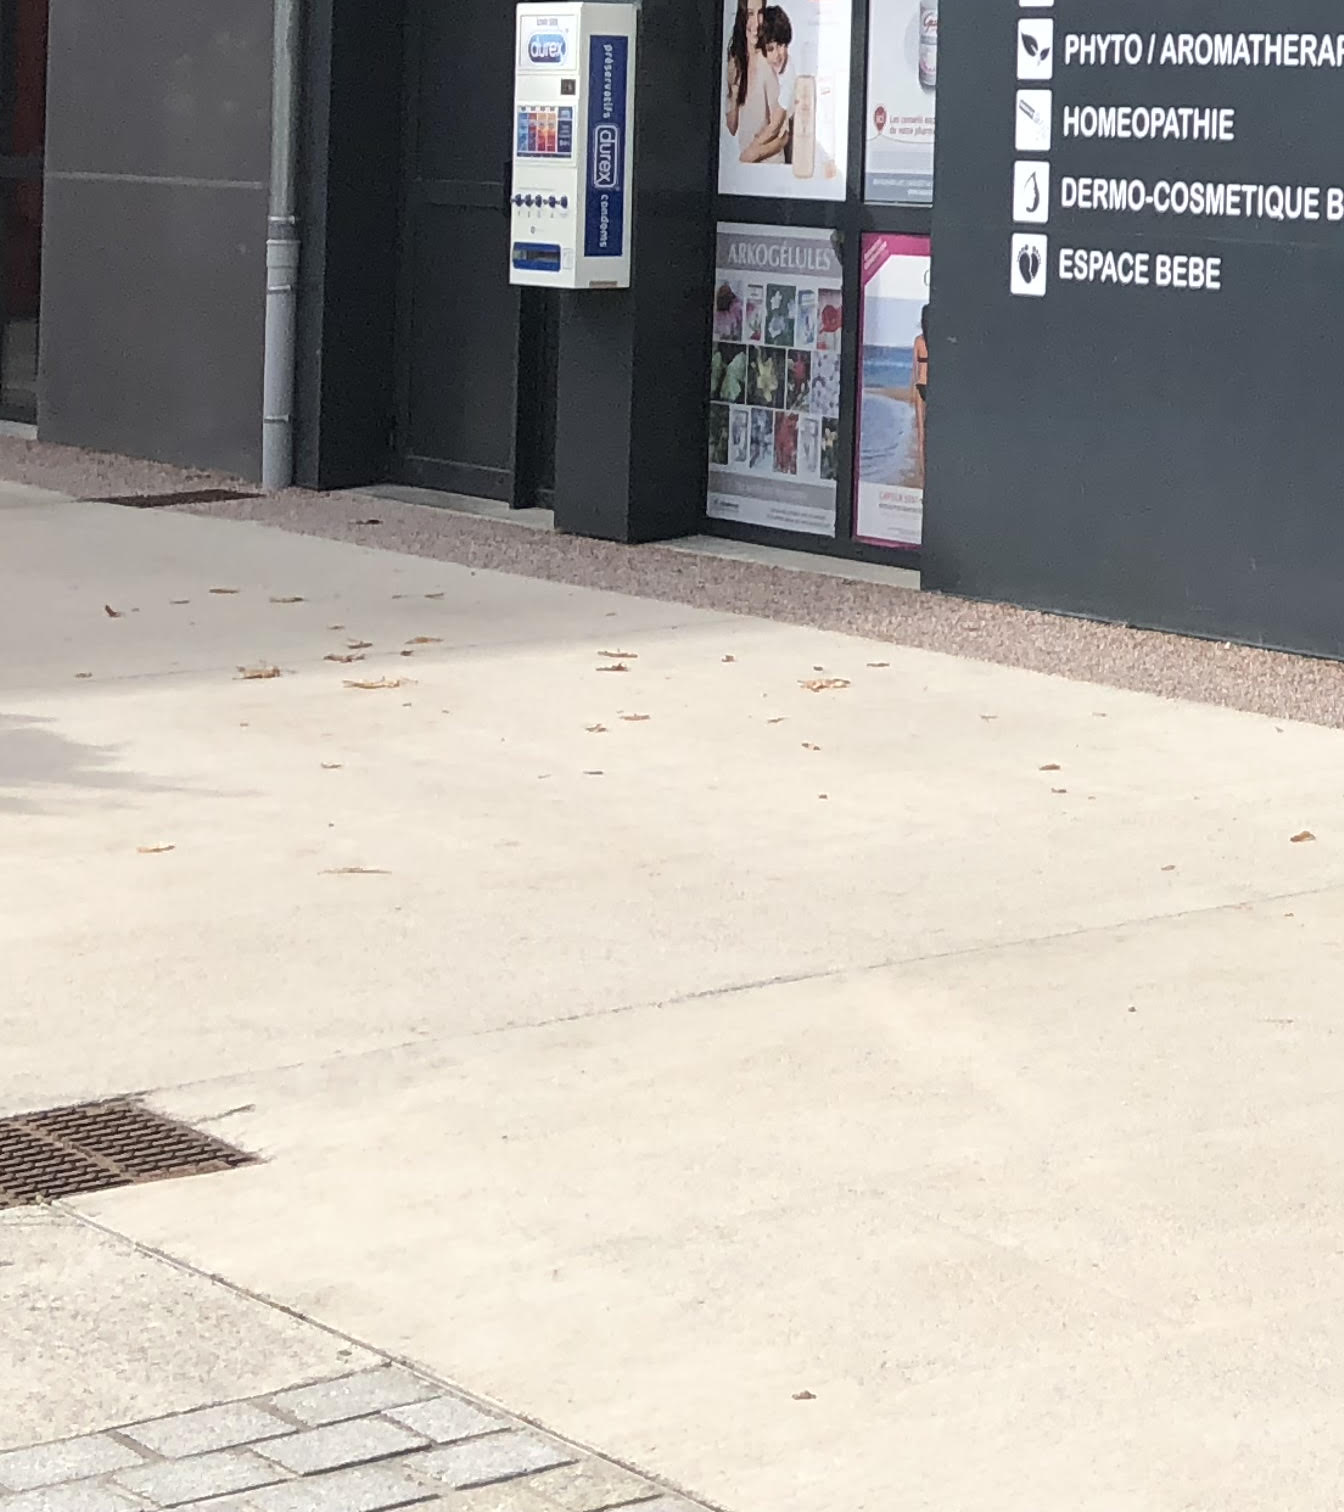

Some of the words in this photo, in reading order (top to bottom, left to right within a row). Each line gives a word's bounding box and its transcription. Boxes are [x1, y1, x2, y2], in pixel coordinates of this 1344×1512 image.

[1065, 34, 1143, 66] PHYTO
[1063, 106, 1235, 141] HOMEOPATHIE
[598, 129, 615, 183] durex
[1061, 177, 1320, 220] DERMO-COSMETIQUE
[728, 240, 831, 270] ARKOGÉLULES
[1059, 248, 1149, 284] ESPACE
[1155, 255, 1221, 289] BEBE
